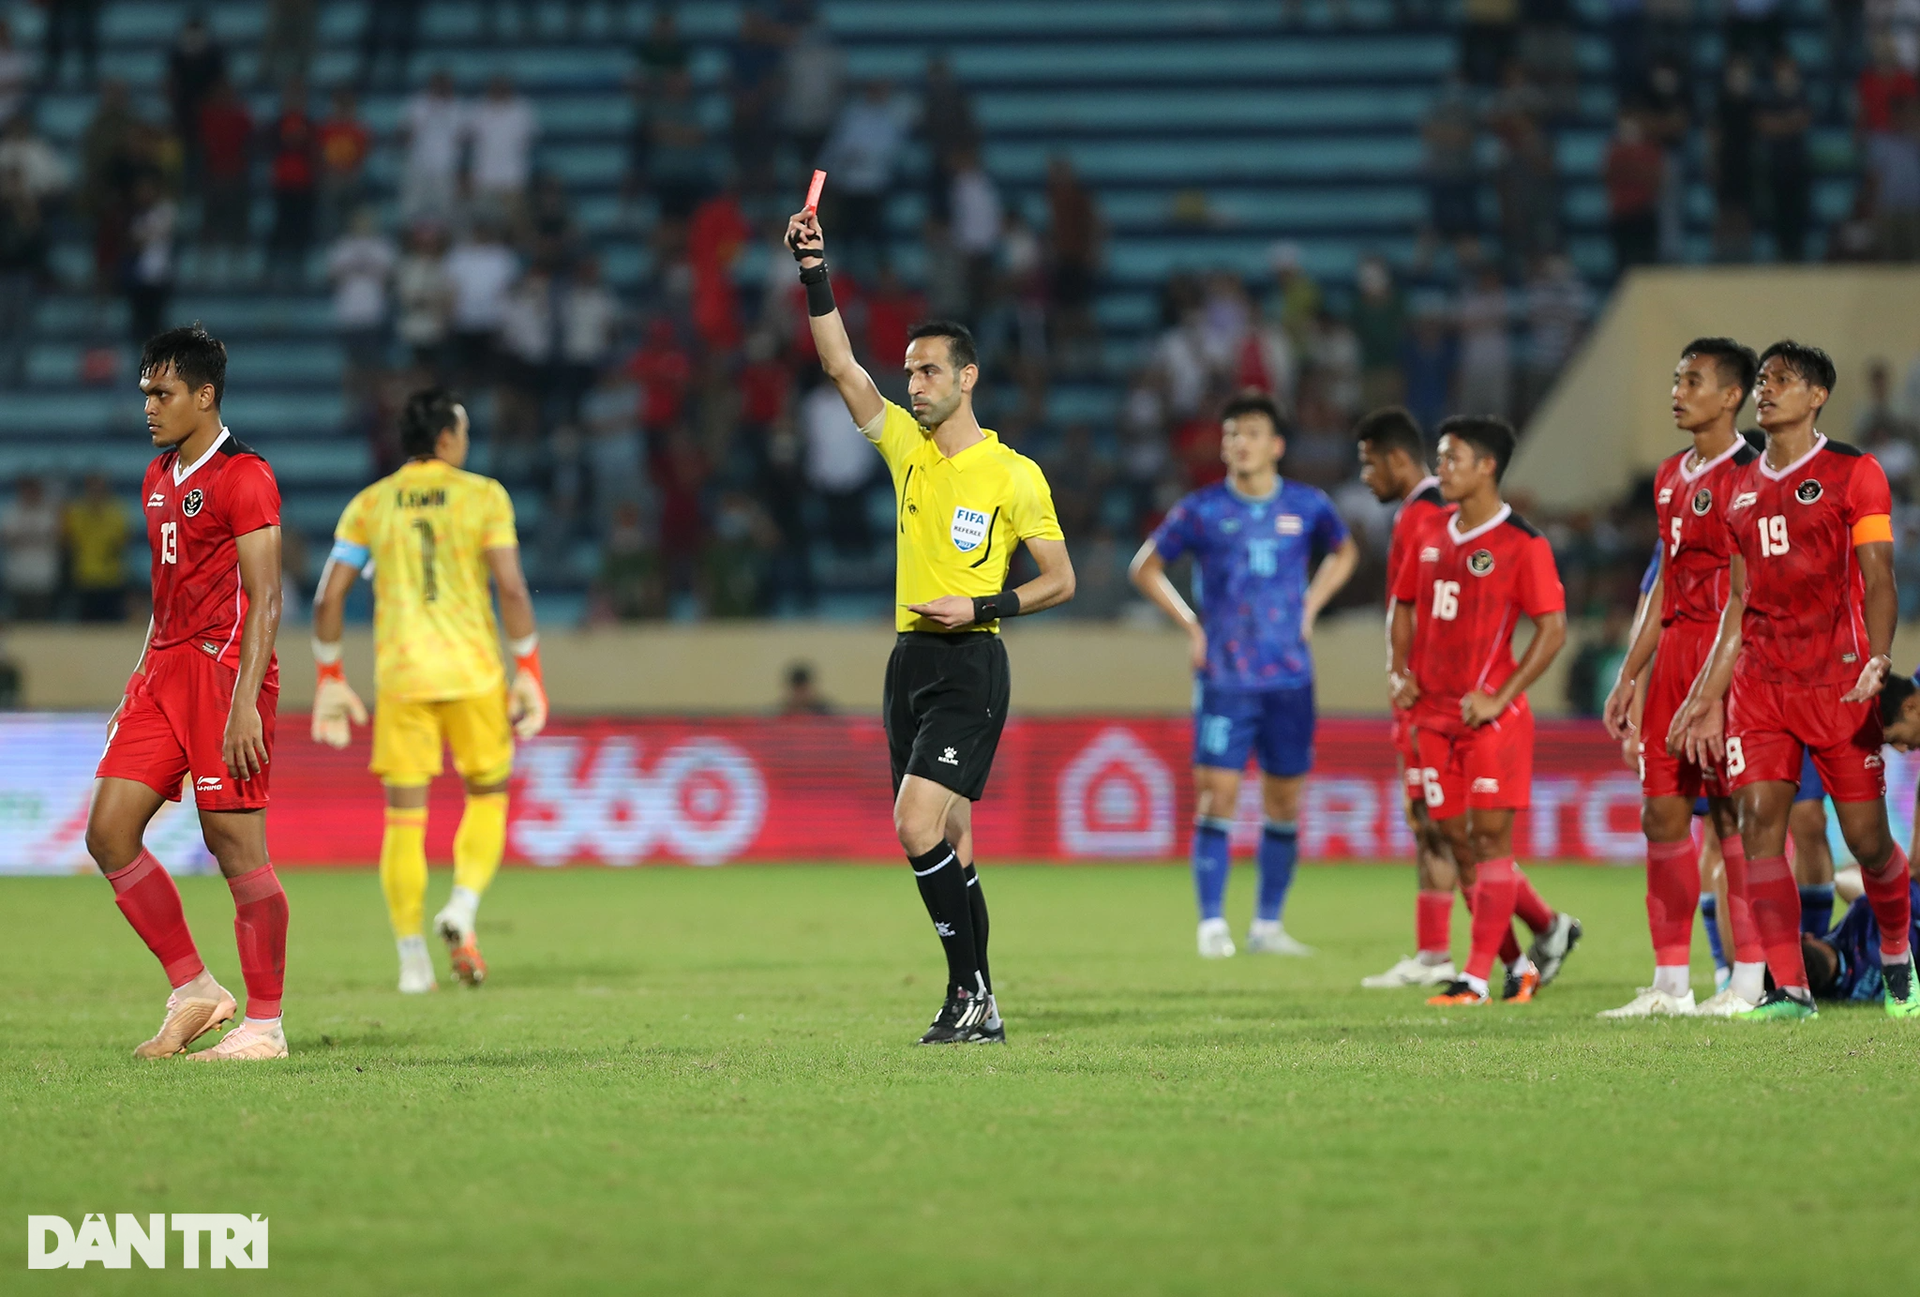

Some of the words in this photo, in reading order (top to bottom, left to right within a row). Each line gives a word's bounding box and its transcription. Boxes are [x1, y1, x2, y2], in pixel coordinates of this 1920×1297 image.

[953, 525, 982, 537] REFEREE
[957, 509, 984, 525] FIFA
[1670, 516, 1683, 558] 5
[1758, 515, 1790, 558] 19
[161, 521, 177, 565] 13
[411, 519, 436, 601] 1
[1431, 579, 1461, 620] 16
[511, 736, 768, 866] 360
[1422, 766, 1445, 808] 6
